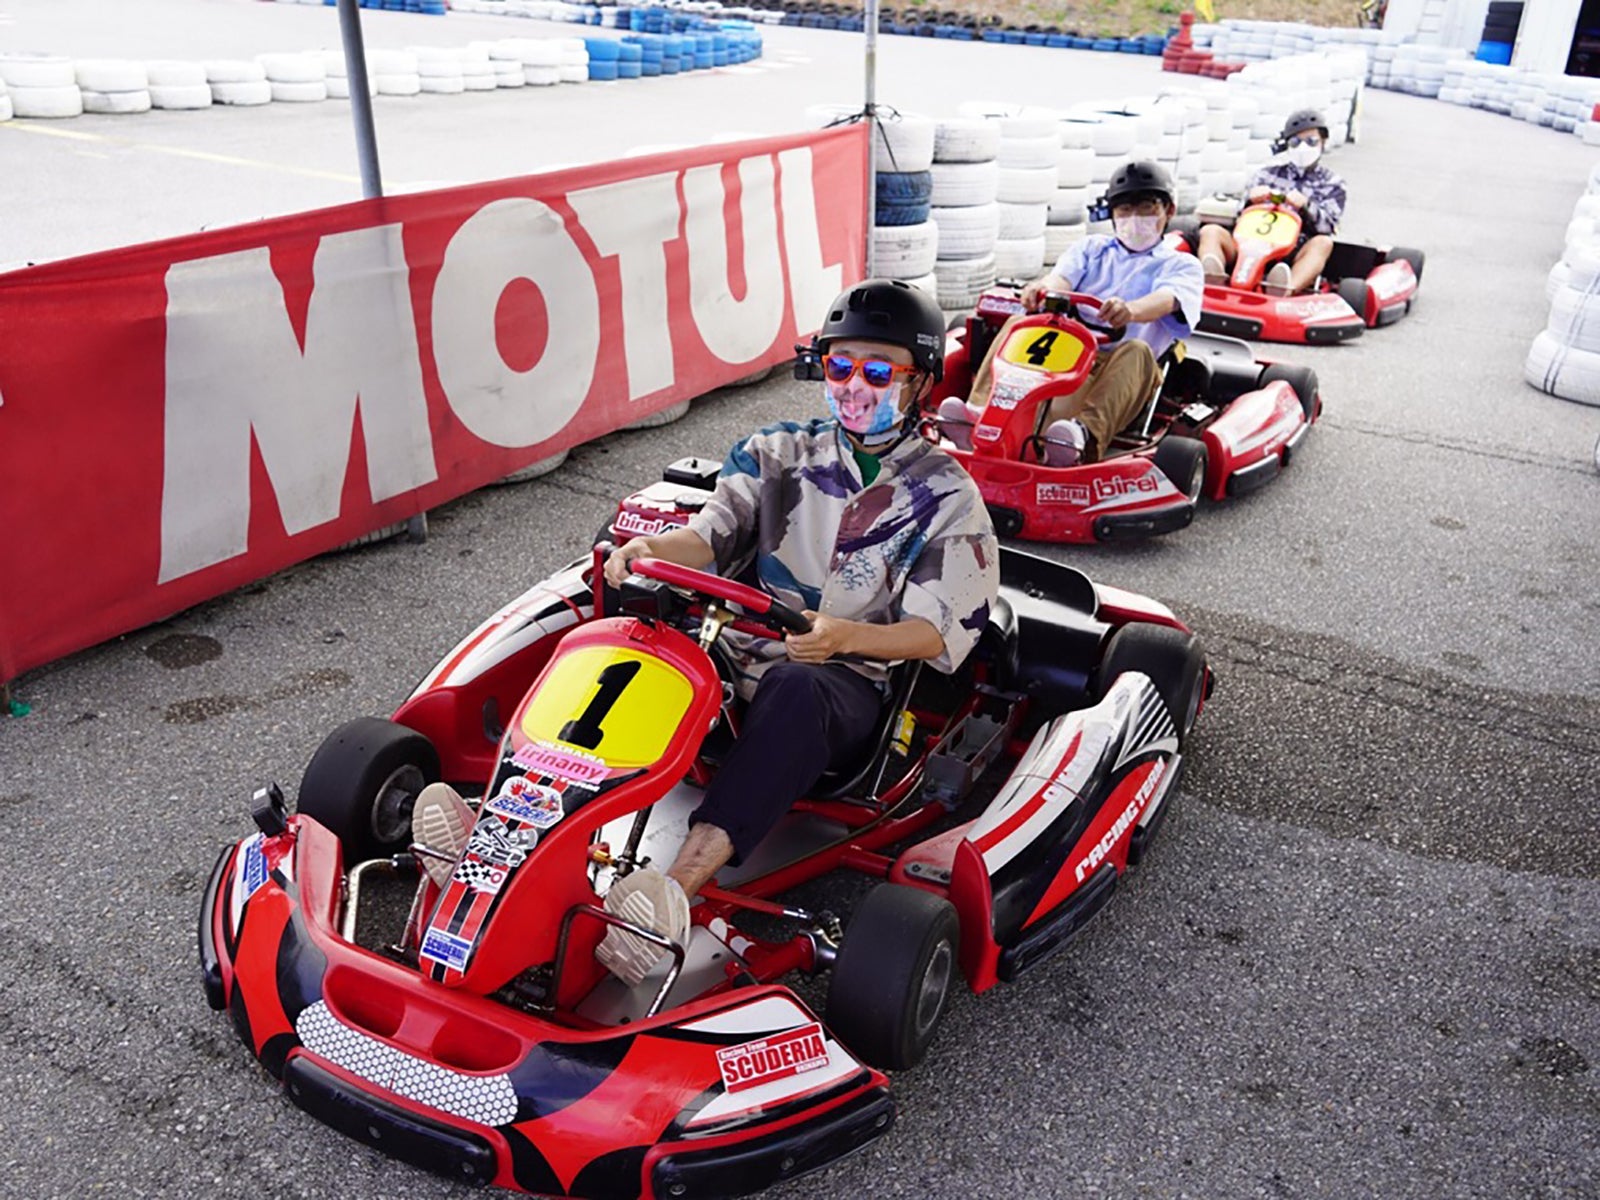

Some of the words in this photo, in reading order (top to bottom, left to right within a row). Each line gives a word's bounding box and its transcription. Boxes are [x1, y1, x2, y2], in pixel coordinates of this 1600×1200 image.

[1255, 210, 1279, 236] 3
[157, 146, 843, 585] MOTUL
[1025, 330, 1060, 366] 4
[1093, 474, 1160, 499] birel
[556, 660, 642, 751] 1
[521, 745, 605, 780] irinamy
[1074, 800, 1141, 883] RACING
[722, 1034, 827, 1083] SCUDERIA
